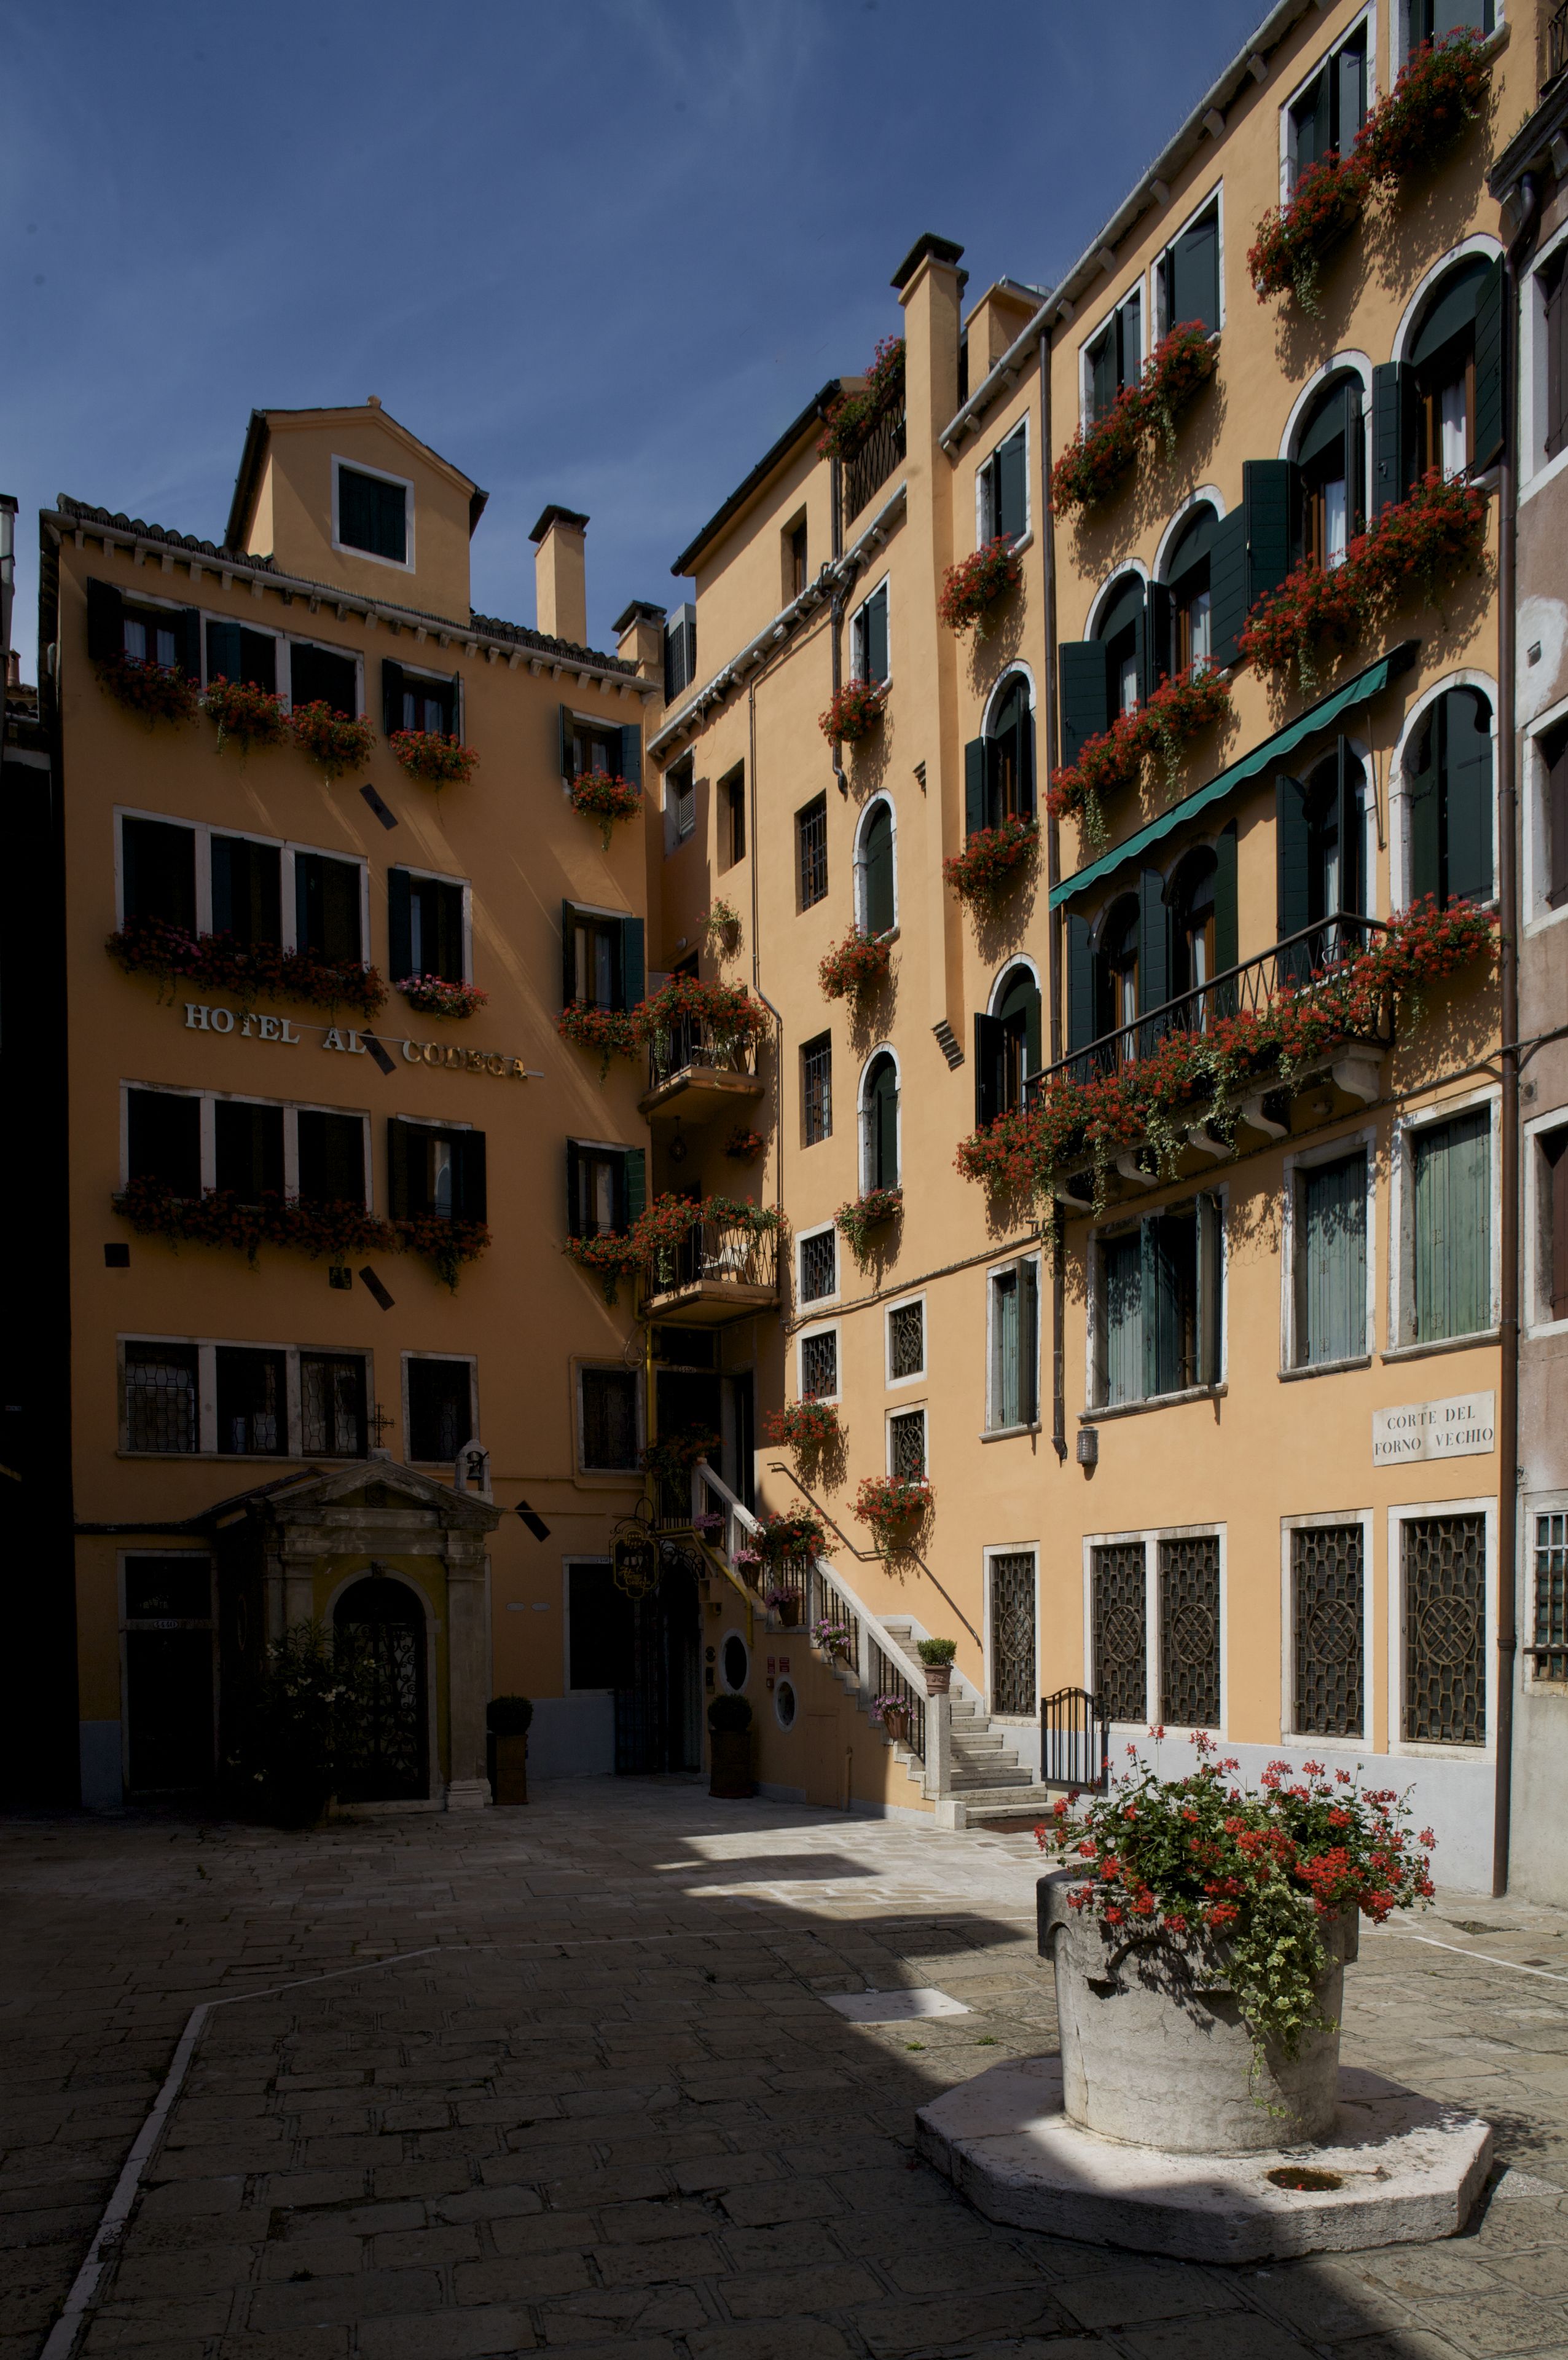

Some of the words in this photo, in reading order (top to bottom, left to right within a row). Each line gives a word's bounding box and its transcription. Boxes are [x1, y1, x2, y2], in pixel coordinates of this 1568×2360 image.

[184, 1002, 301, 1045] HOTEL
[322, 1027, 367, 1055] AL
[402, 1039, 528, 1080] CODEGA
[1387, 1410, 1437, 1430] CORTE
[1445, 1405, 1475, 1422] DEL
[1374, 1437, 1422, 1456] FORNO
[1435, 1427, 1493, 1447] VECHIO
